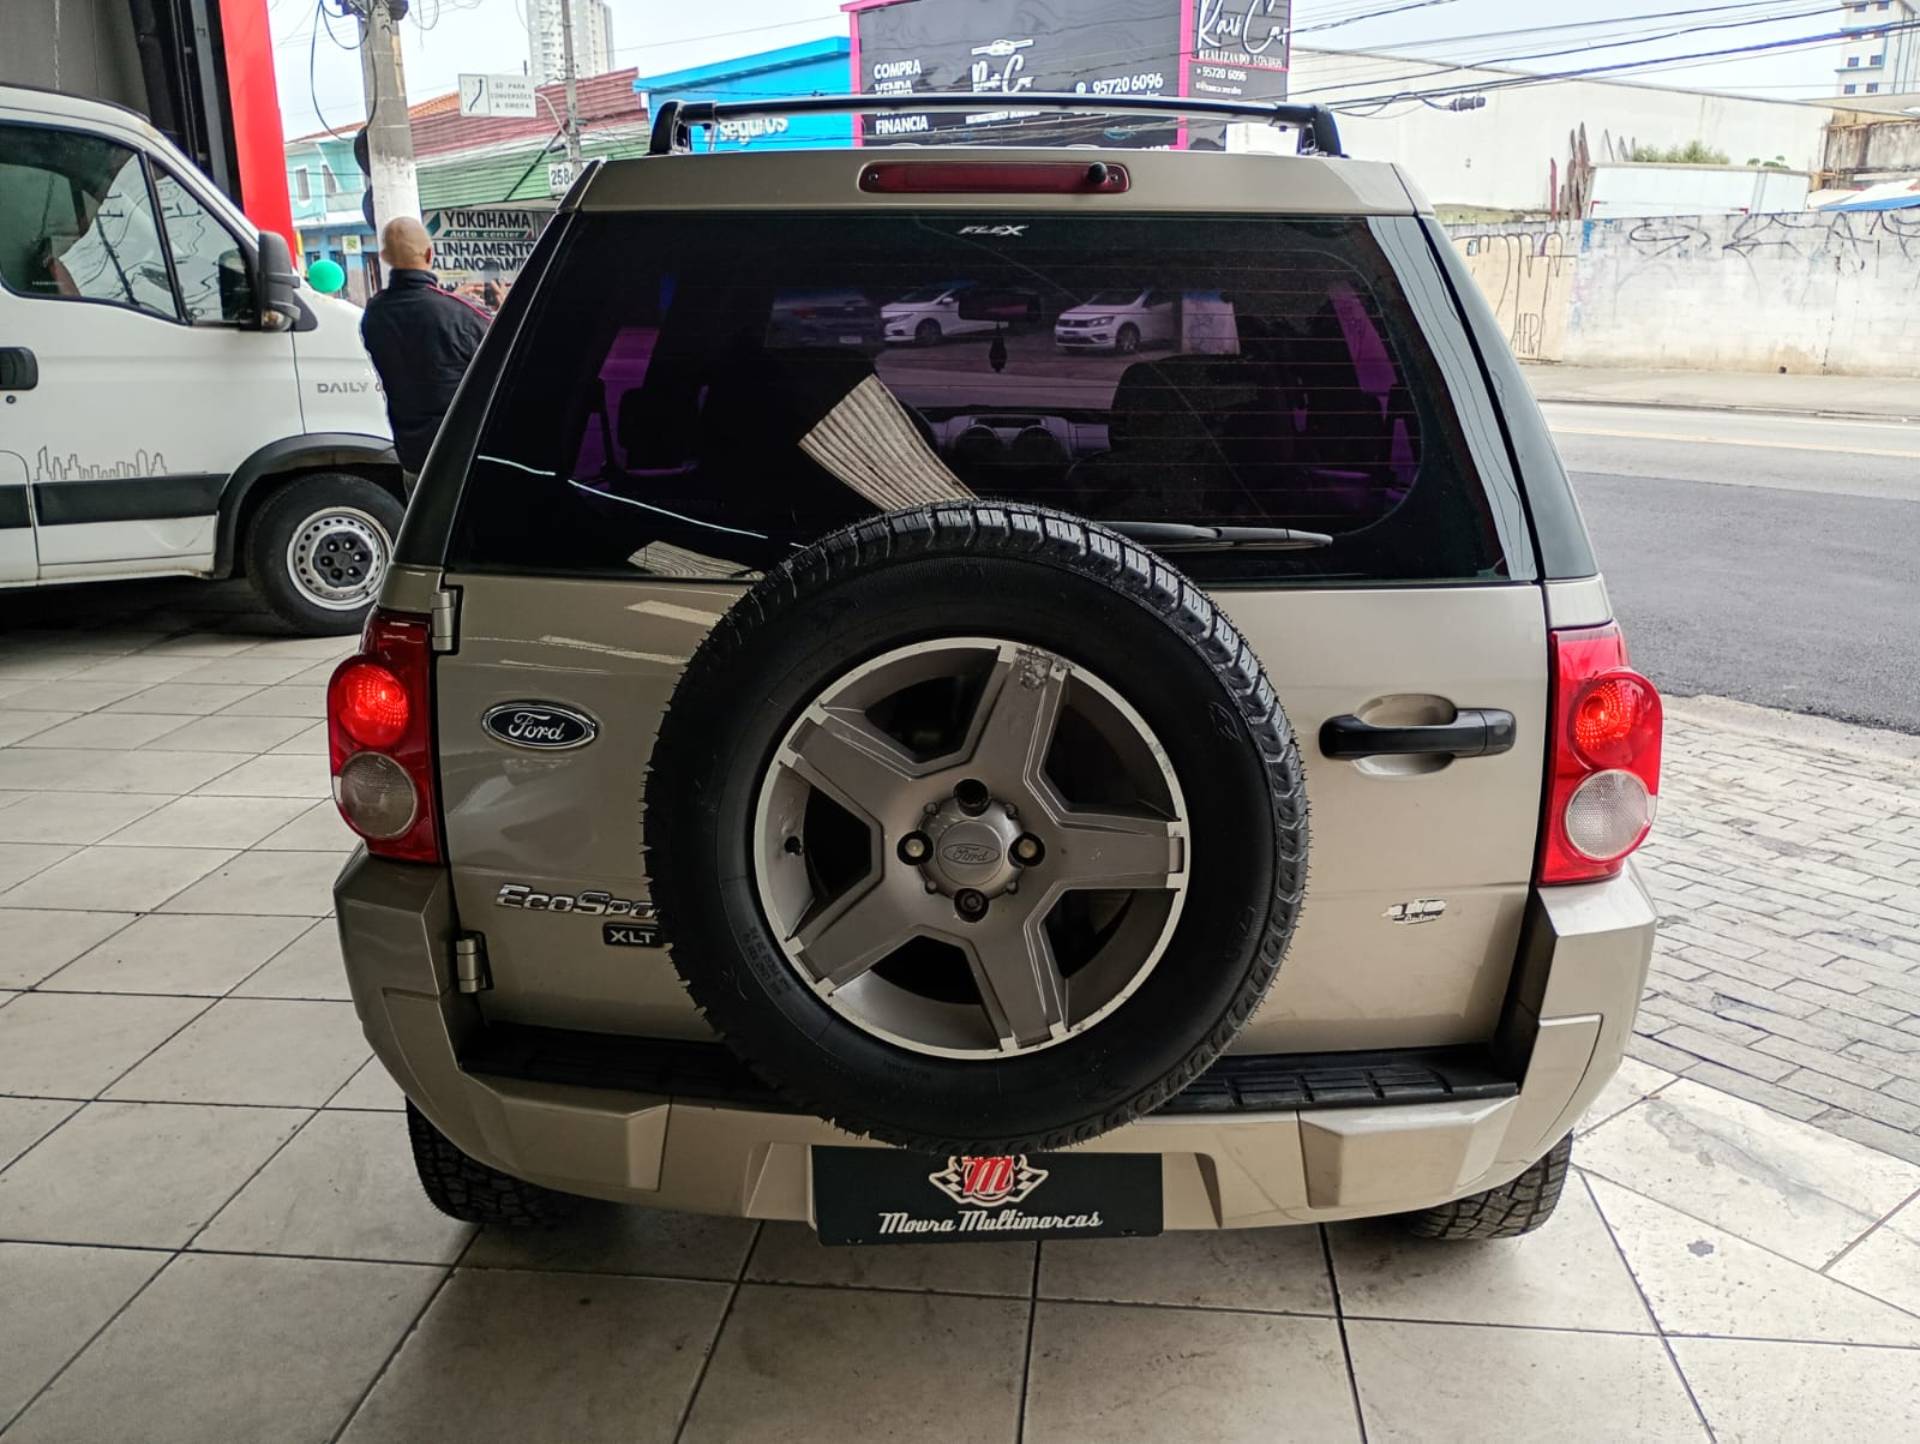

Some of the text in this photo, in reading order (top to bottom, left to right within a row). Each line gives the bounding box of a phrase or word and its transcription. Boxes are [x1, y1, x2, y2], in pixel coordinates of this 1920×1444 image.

[874, 59, 922, 80] COMPRA
[1092, 72, 1164, 96] 95720 6096
[875, 115, 929, 135] FINANCIA
[444, 210, 532, 229] YOKOHAMA
[433, 242, 535, 257] LINHAMENTO
[316, 382, 369, 394] DAILY
[508, 711, 566, 742] Ford
[953, 846, 989, 862] Ford
[496, 884, 657, 920] EcoSpo
[610, 929, 656, 944] XLT
[878, 1208, 1103, 1235] Moura Multimarcas
